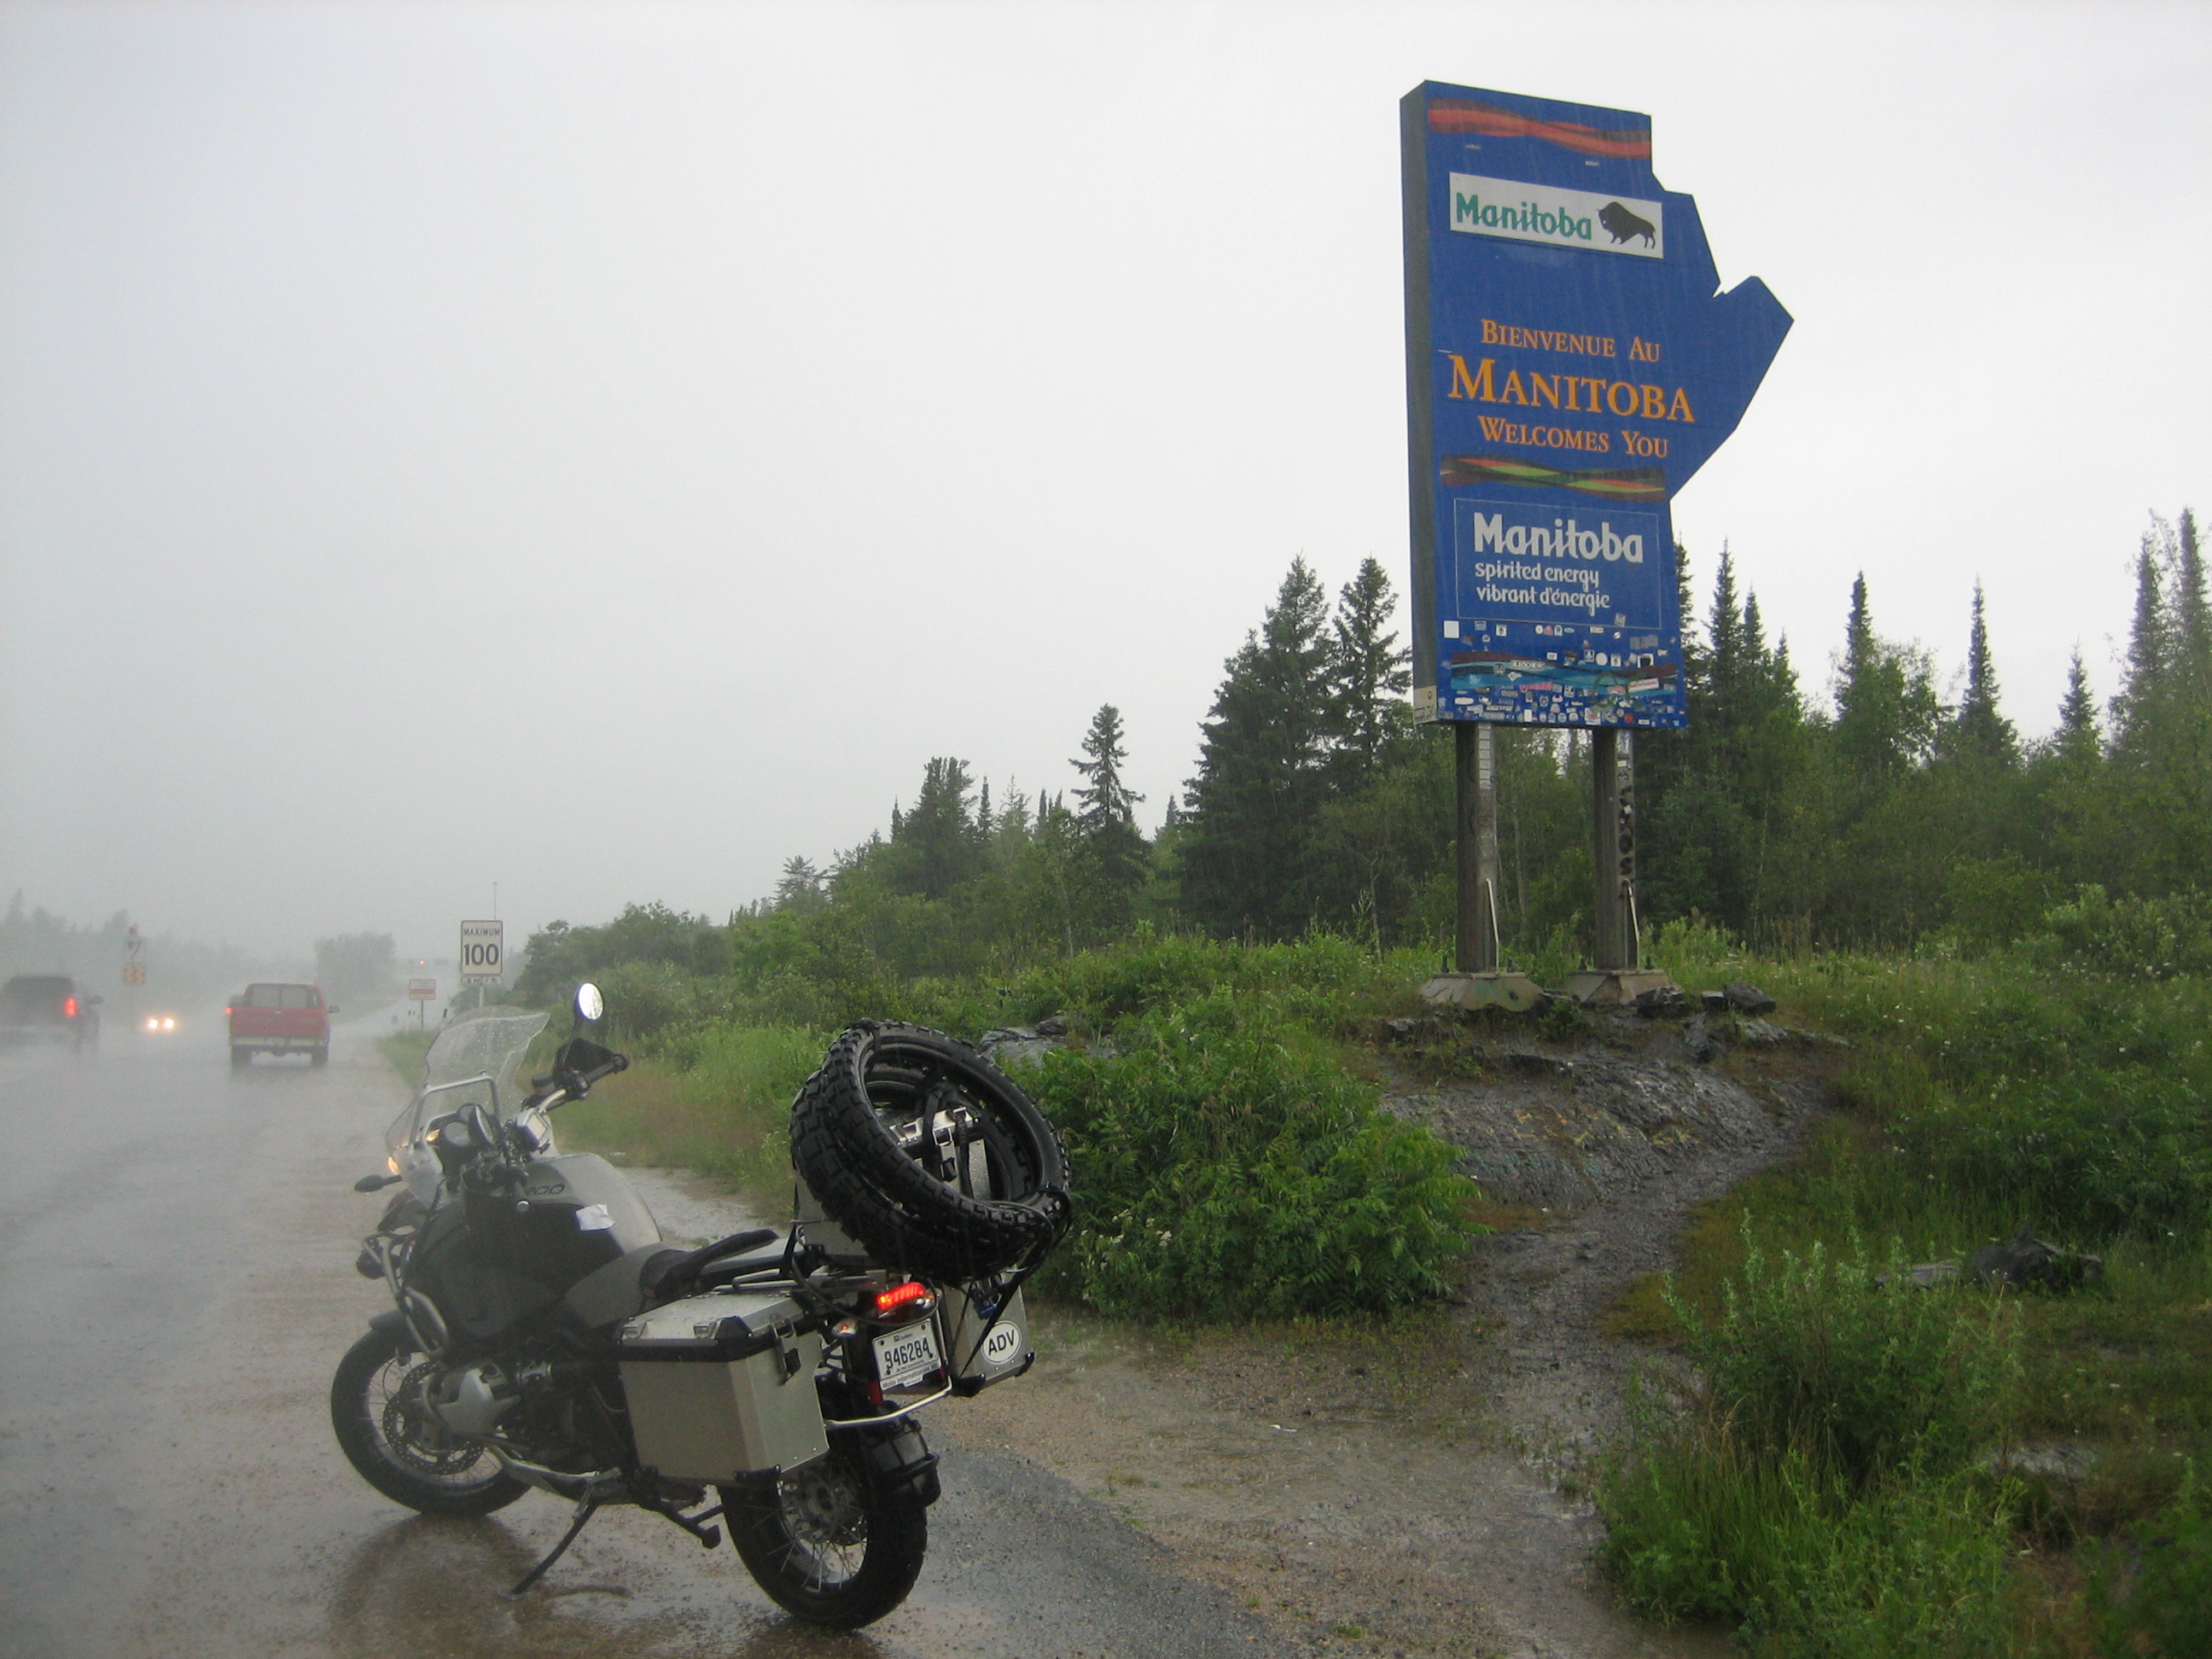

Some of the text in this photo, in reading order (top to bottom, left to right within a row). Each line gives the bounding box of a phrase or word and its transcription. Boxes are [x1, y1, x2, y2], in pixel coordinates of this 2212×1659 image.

[1455, 192, 1592, 241] Manitoba
[1481, 318, 1661, 363] BIENVENUE AU
[1447, 354, 1696, 422] MANITOBA
[1477, 415, 1669, 458] WELCOMES YOU
[1473, 512, 1644, 563] Manitoba
[1475, 560, 1599, 592] spirited energy
[1476, 584, 1610, 616] vibrant d'énergie
[463, 928, 500, 936] MAXIMUM
[463, 943, 499, 966] 100
[884, 1336, 930, 1369] 946284
[987, 1329, 1016, 1356] ADV
